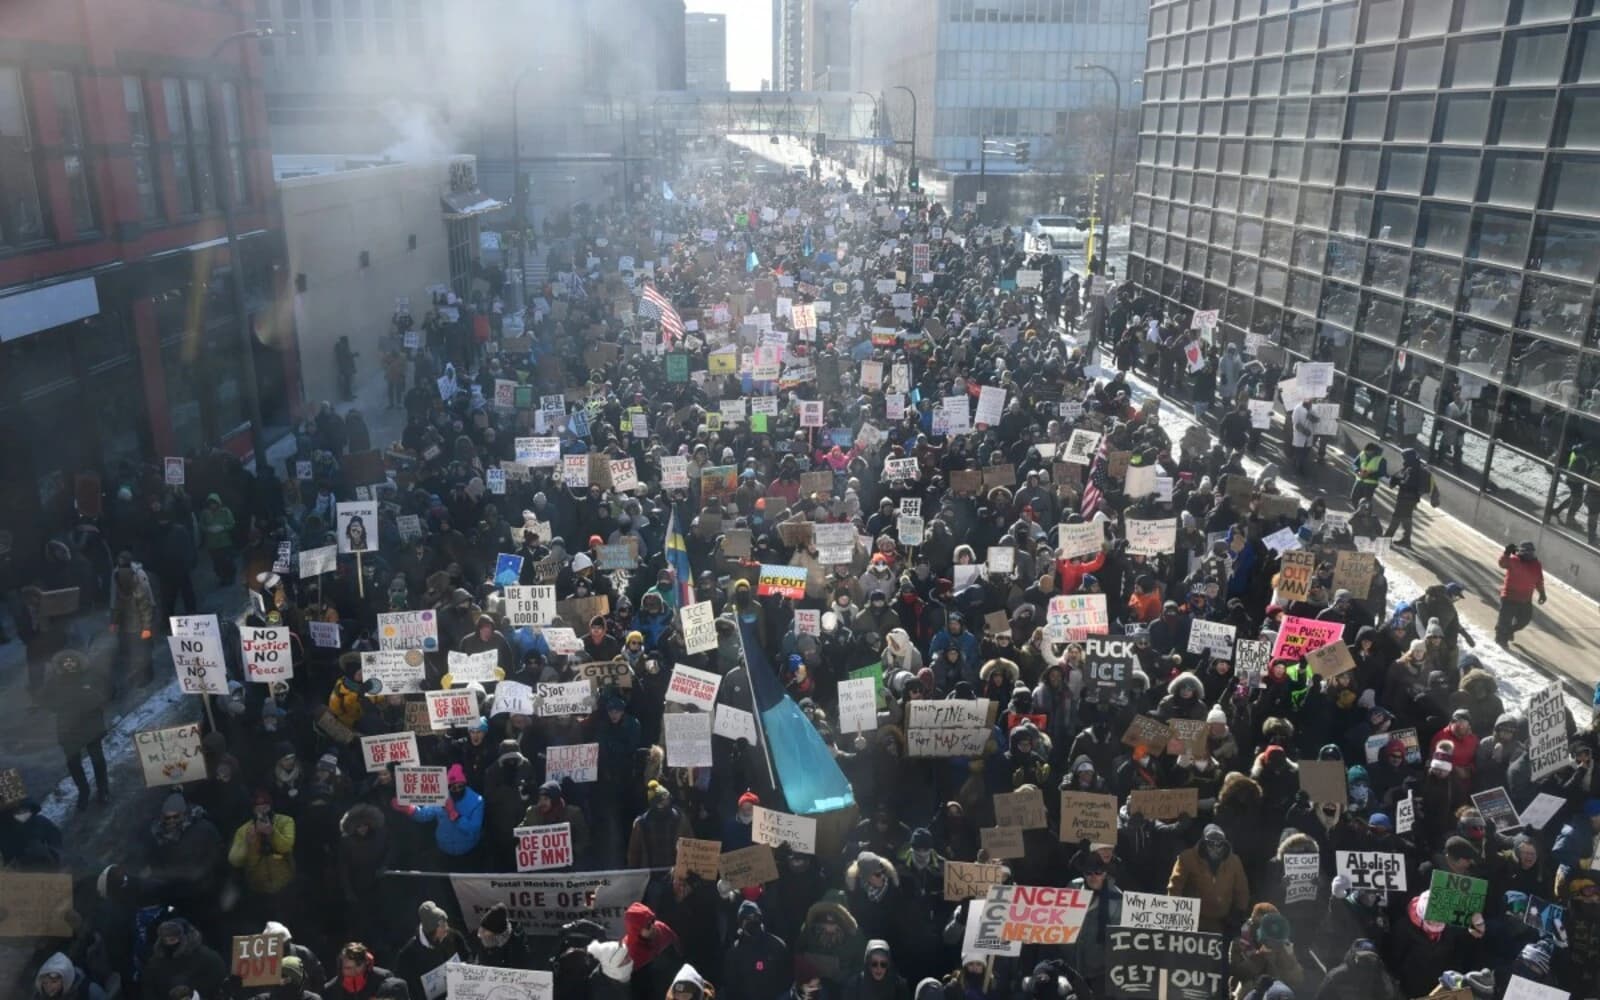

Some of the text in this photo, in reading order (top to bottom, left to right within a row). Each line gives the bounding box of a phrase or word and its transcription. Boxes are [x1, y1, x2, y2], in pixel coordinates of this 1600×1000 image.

[611, 460, 633, 474] FUCK
[1286, 553, 1313, 566] ICE
[1283, 567, 1310, 581] OUT
[761, 576, 804, 587] ICE OUT
[1281, 581, 1307, 595] MN
[507, 587, 551, 599] ICE OUT
[518, 601, 539, 611] FOR
[687, 606, 705, 619] ICE
[176, 619, 188, 628] If
[798, 612, 814, 622] ICE
[1287, 616, 1300, 624] ICE
[253, 630, 277, 641] NO
[181, 640, 203, 653] NO
[243, 640, 288, 651] Justice
[382, 637, 423, 650] RIGHTS
[1086, 639, 1134, 658] FUCK
[254, 650, 278, 663] NO
[1280, 645, 1302, 657] FOR
[176, 655, 217, 666] Justice
[187, 667, 207, 678] NO
[248, 664, 285, 675] Peace
[584, 663, 629, 677] GTFO
[1090, 662, 1125, 680] ICE
[183, 678, 217, 689] Peace
[673, 676, 700, 690] JUSTICE
[702, 683, 715, 693] FOR
[539, 683, 565, 698] STOP
[434, 697, 469, 707] ICE OUT
[1531, 687, 1549, 709] MN
[436, 706, 471, 717] OF MN!
[934, 705, 965, 724] FINE
[1530, 692, 1564, 724] PRETTI
[1532, 711, 1565, 736] GOOD
[371, 742, 409, 753] ICE OUT
[935, 732, 959, 751] MAD
[373, 751, 410, 762] OF MN!
[403, 773, 439, 783] ICE OUT
[404, 784, 440, 793] OF MN!
[1400, 805, 1412, 817] ICE
[763, 812, 785, 826] ICE
[1072, 816, 1110, 830] AMERICA
[542, 832, 568, 848] OUT
[519, 848, 569, 867] OF MN!
[1285, 856, 1318, 865] ICE OUT
[1347, 853, 1400, 870] Abolish
[947, 864, 1001, 884] No ICE
[1301, 872, 1318, 880] OUT
[1351, 869, 1398, 889] ICE
[490, 880, 521, 888] Postal
[524, 880, 564, 889] Workers
[947, 882, 963, 896] No
[1299, 886, 1316, 895] OUT
[1446, 875, 1472, 893] NO
[509, 891, 596, 908] ICE OFF
[1126, 894, 1193, 912] Why Are YOU
[1131, 912, 1152, 923] NOT
[239, 938, 279, 958] ICE
[236, 957, 278, 979] OUT
[1110, 965, 1222, 993] GET OUT
